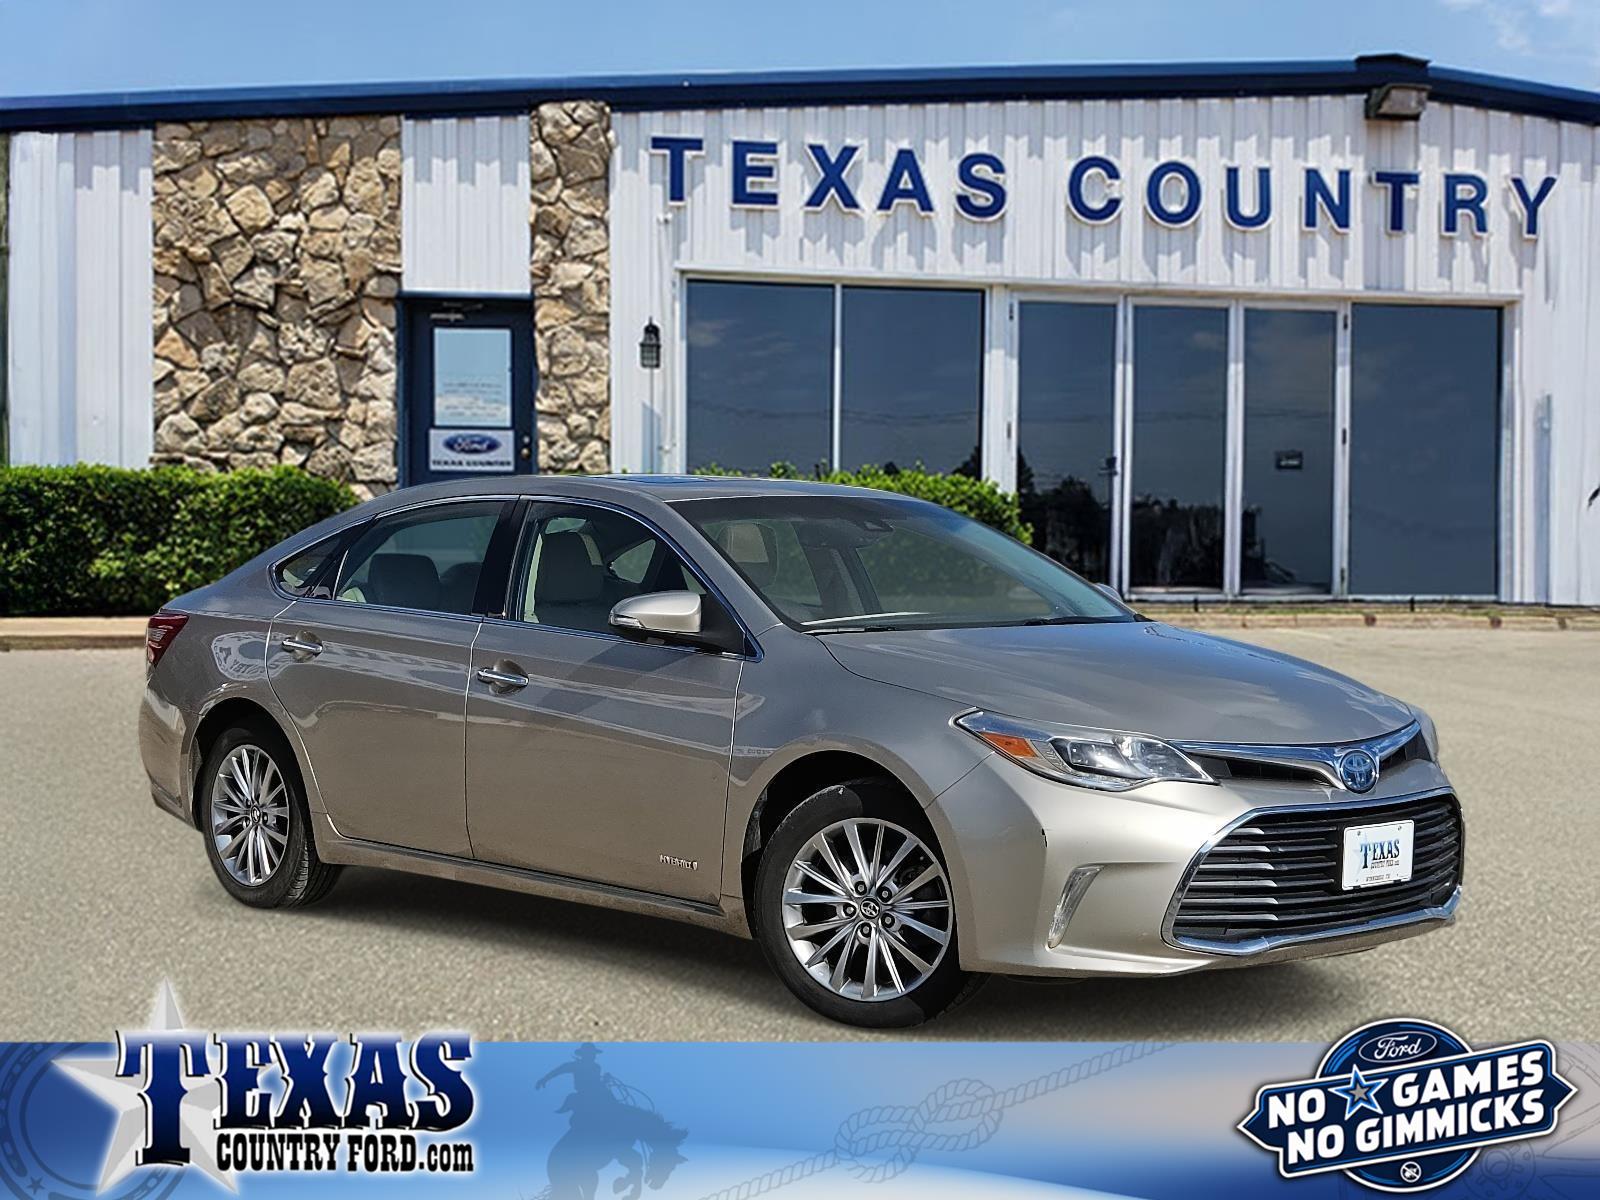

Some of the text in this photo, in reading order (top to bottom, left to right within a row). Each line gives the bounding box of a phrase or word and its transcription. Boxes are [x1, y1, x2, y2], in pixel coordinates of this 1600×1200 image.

[650, 136, 1558, 238] TEXAS COUNTRY
[1360, 839, 1400, 869] TEXAS
